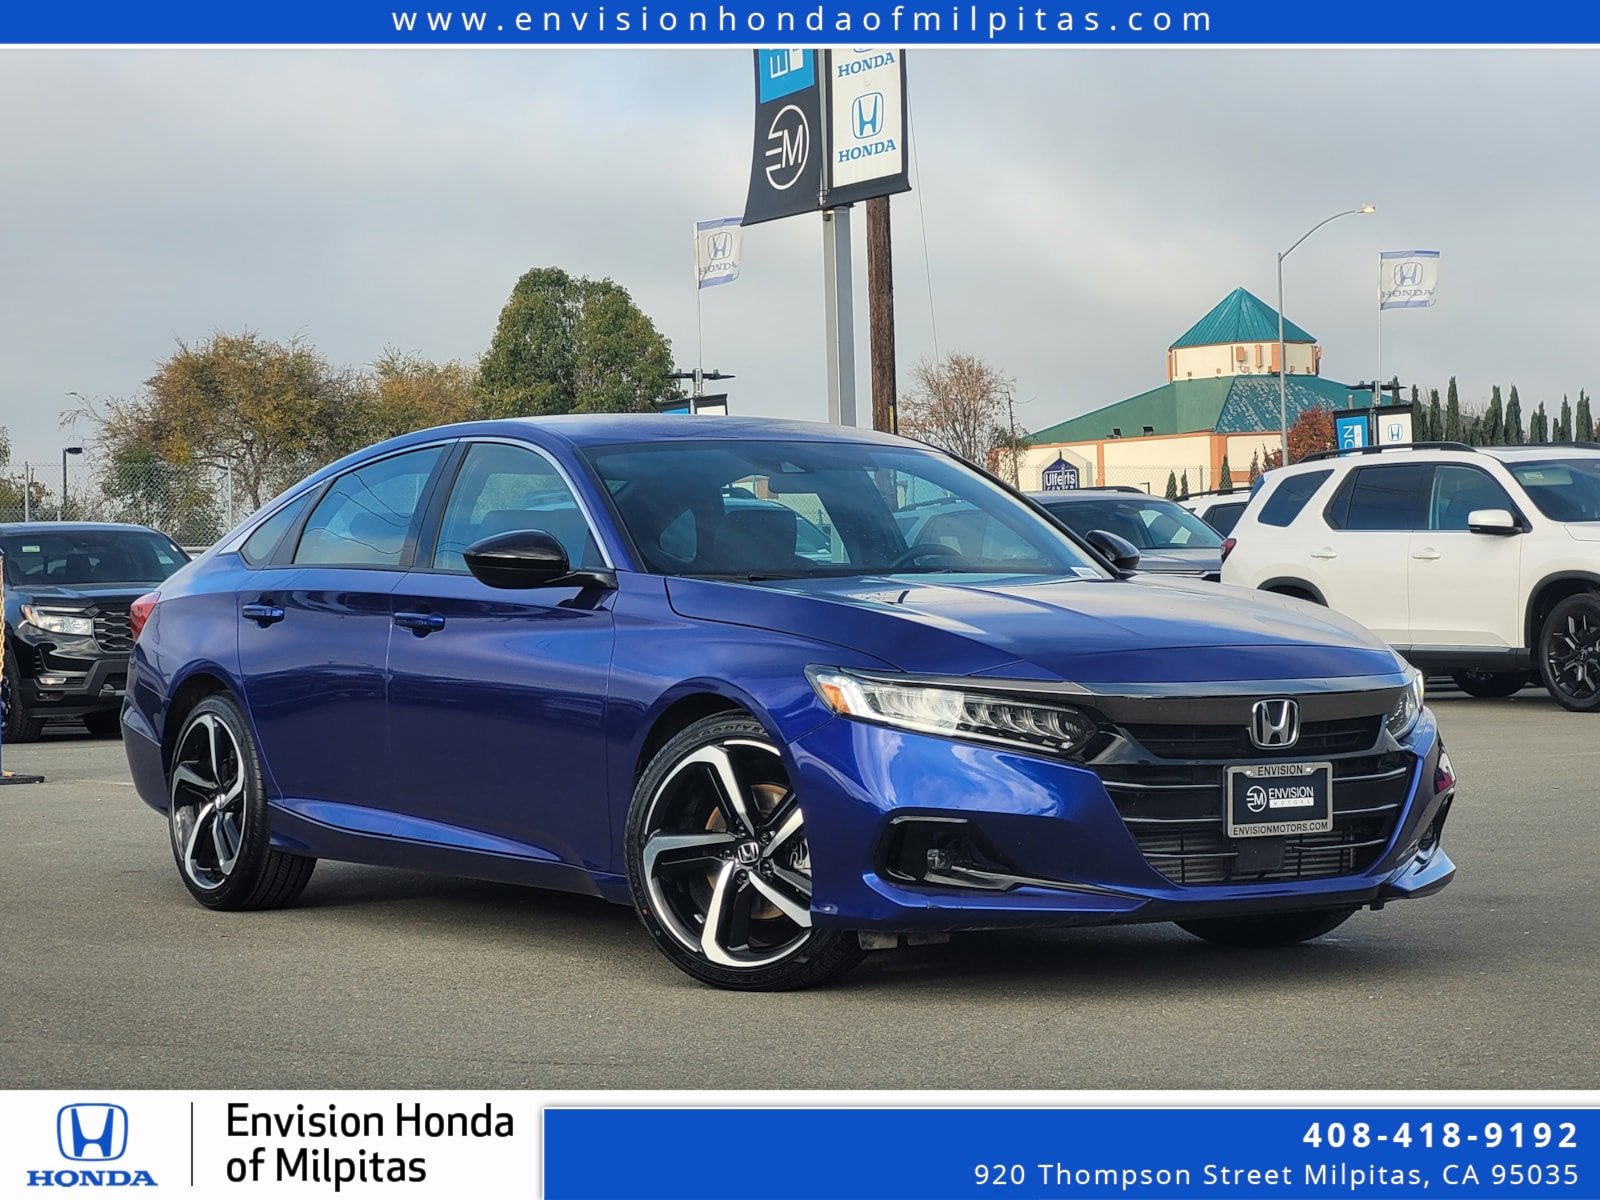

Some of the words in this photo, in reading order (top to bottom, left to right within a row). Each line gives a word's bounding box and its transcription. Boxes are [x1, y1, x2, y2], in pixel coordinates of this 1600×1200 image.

[837, 52, 896, 78] HONDA
[838, 139, 896, 162] HONDA
[1257, 765, 1303, 776] ENVISION
[1268, 786, 1314, 799] ENVISION
[1233, 822, 1328, 835] ENVISIONMOTORS.COM
